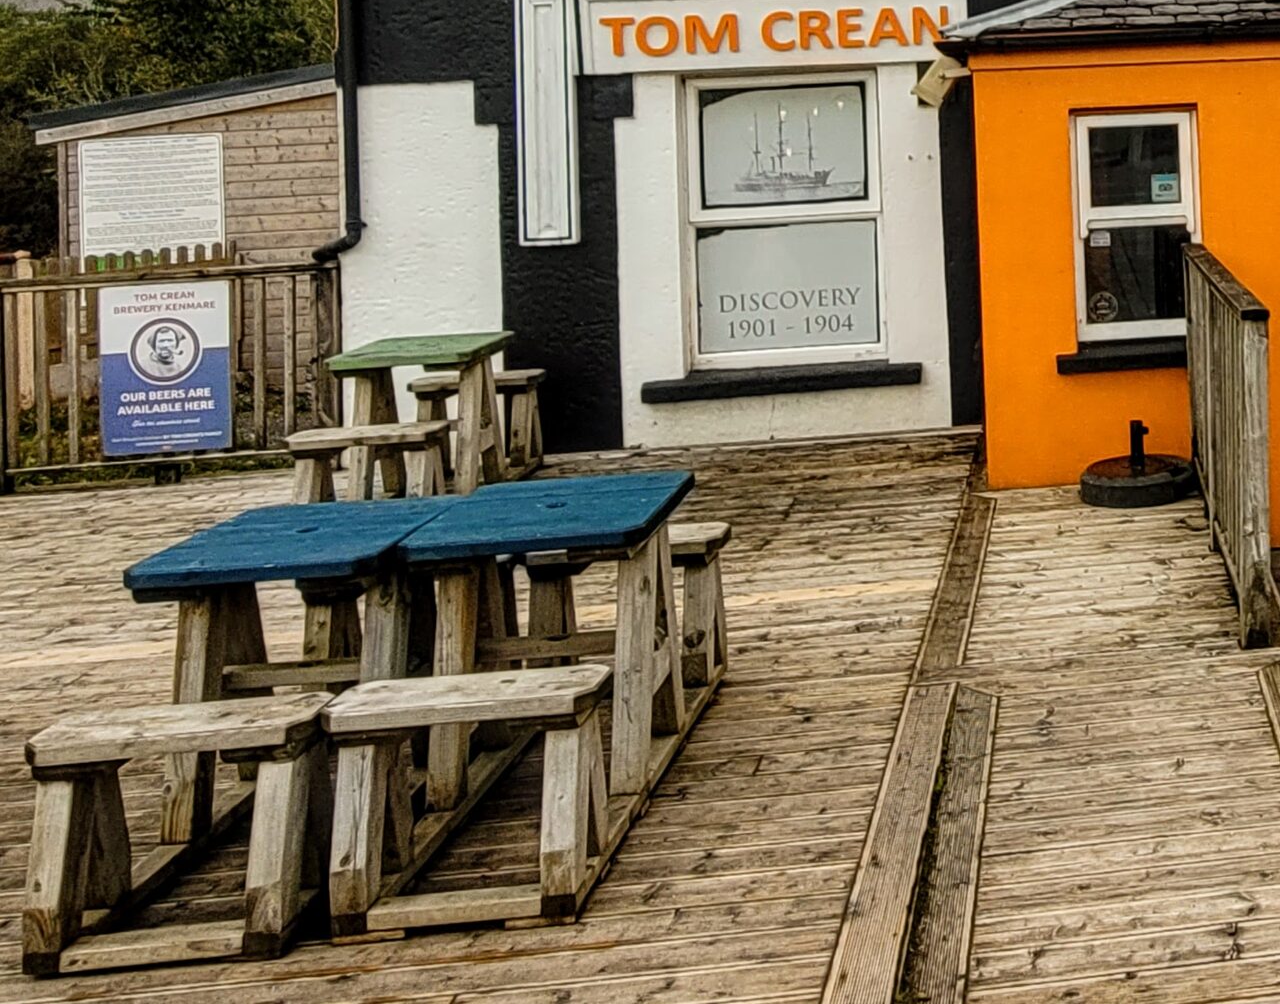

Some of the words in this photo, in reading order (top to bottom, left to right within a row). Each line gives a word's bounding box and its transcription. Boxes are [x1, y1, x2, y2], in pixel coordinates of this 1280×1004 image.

[599, 13, 740, 56] TOM
[760, 6, 949, 52] CREAN
[134, 293, 157, 302] TOM
[160, 291, 195, 300] CREAN
[719, 287, 860, 313] DISCOVERY
[114, 304, 162, 314] BREWERY
[165, 300, 216, 311] KENMARE
[728, 319, 775, 339] 1901
[805, 314, 853, 334] 1904
[120, 392, 146, 402] OUR
[149, 389, 185, 400] BEERS
[187, 387, 211, 398] ARE
[117, 402, 182, 416] AVAILABLE
[184, 400, 215, 411] HERE
